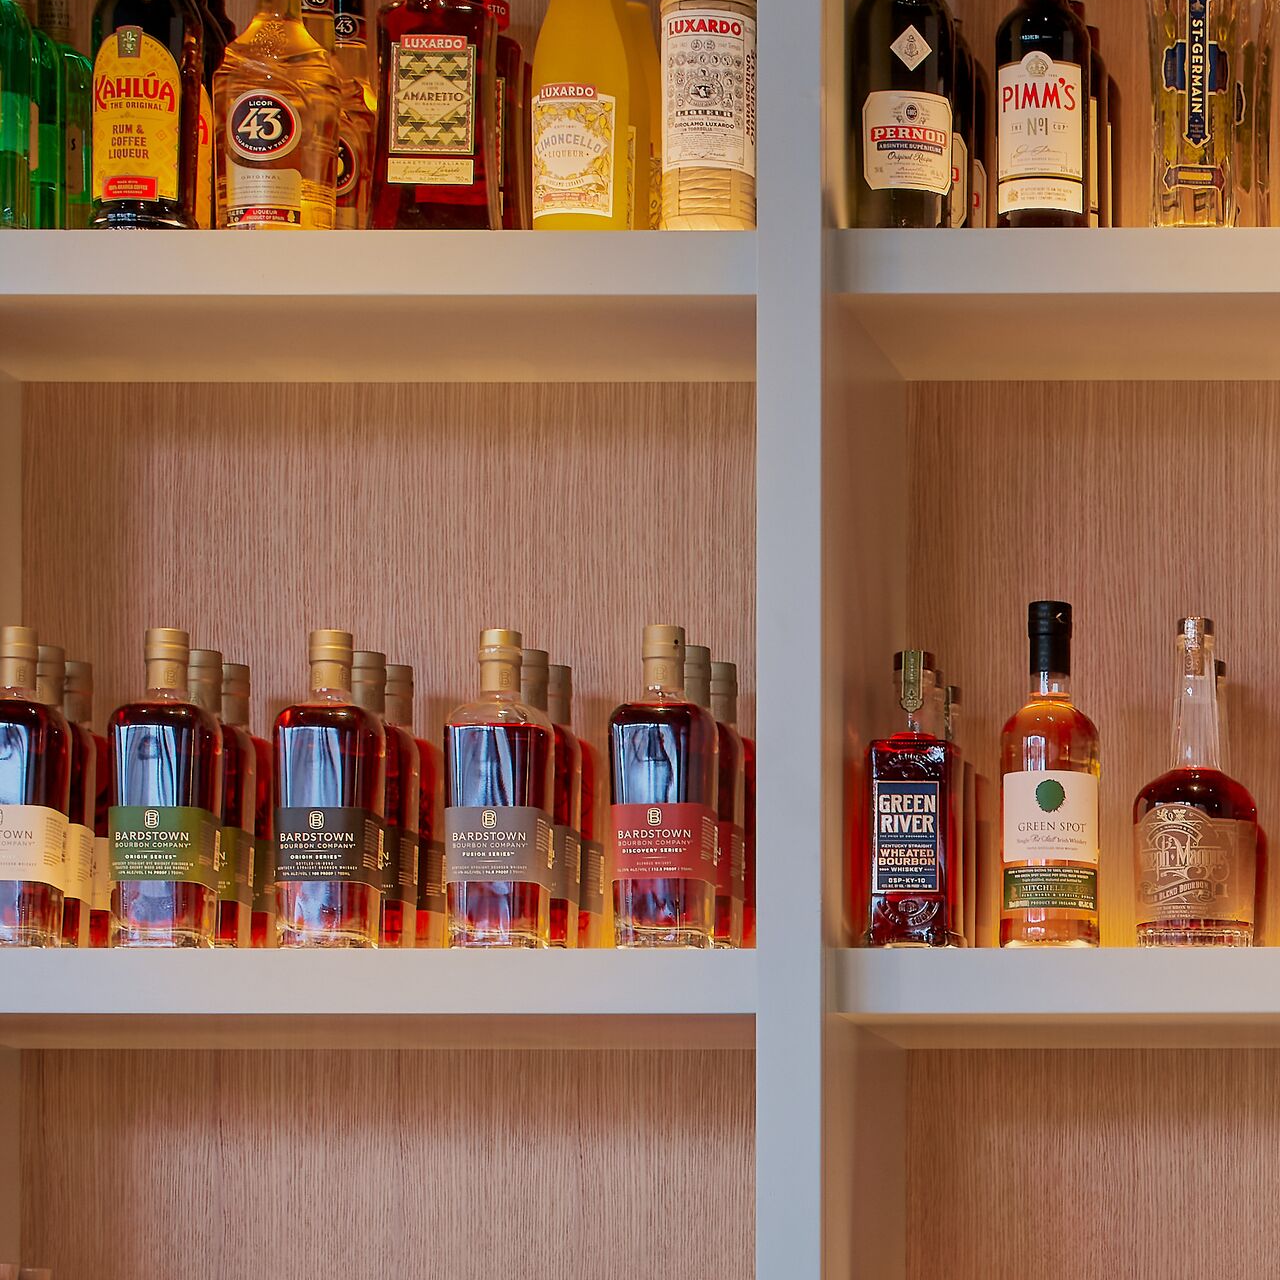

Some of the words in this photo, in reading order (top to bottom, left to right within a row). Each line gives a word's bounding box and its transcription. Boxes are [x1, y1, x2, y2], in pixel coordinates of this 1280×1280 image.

[335, 20, 353, 33] 43
[668, 18, 742, 36] LUXARDO
[404, 37, 463, 50] LUXARDO
[95, 72, 175, 112] KAHLÚA
[403, 91, 464, 102] AMARETTO
[540, 86, 594, 99] LUXARDO
[1003, 77, 1076, 113] PIMM'S
[126, 102, 163, 111] ORIGINAL
[112, 124, 133, 134] RUM
[136, 124, 144, 134] &
[237, 107, 283, 140] 43
[874, 127, 946, 145] PERNOD
[111, 137, 147, 147] COFFEE
[536, 133, 602, 155] LIMONCELLO
[108, 148, 149, 160] LIQUEUR
[548, 149, 584, 159] LIQUEUR
[879, 794, 936, 814] GREEN
[880, 814, 934, 834] RIVER
[1018, 821, 1055, 832] GREEN
[1059, 821, 1086, 832] SPOT
[115, 831, 189, 842] BARDSTOWN
[280, 832, 354, 843] BARDSTOWN
[452, 831, 526, 842] BARDSTOWN
[618, 829, 691, 839] BARDSTOWN
[880, 848, 934, 858] WHEATED
[879, 857, 935, 866] BOURBON
